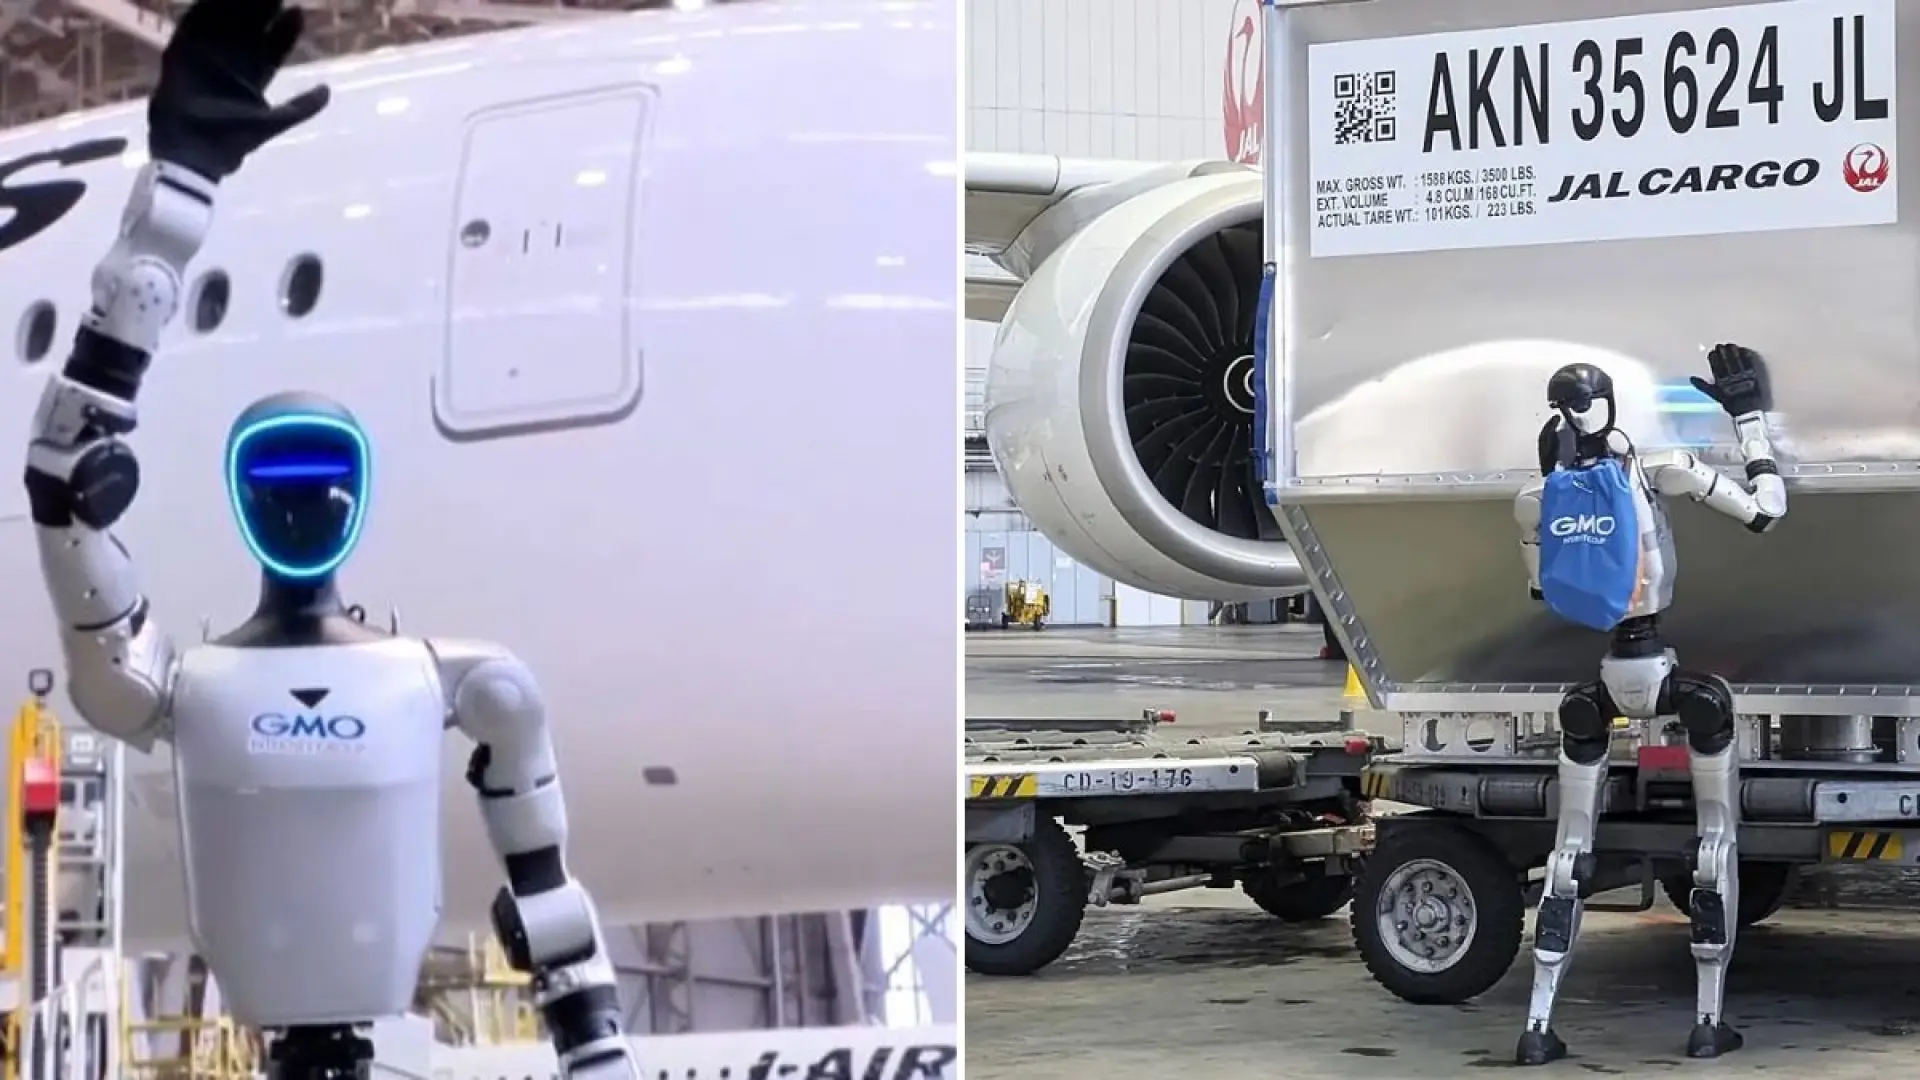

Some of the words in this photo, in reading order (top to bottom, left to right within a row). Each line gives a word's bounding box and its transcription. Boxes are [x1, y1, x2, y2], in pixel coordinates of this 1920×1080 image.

[1422, 43, 1550, 153] AKN
[1571, 37, 1645, 142] 35
[1663, 25, 1784, 134] 624
[1812, 15, 1889, 123] JL
[1237, 122, 1260, 161] JAL
[1317, 179, 1343, 194] MAX.
[1345, 176, 1384, 192] GROSS
[1386, 174, 1406, 189] WT.
[1421, 172, 1445, 187] 1588
[1447, 170, 1474, 185] KGS.
[1481, 167, 1508, 182] 3500
[1511, 165, 1537, 180] LBS.
[1548, 171, 1630, 203] JAL
[1638, 158, 1820, 196] CARGO
[1852, 177, 1878, 188] JAL
[1317, 196, 1340, 211] EXT.
[1342, 192, 1388, 209] VOLUME
[1426, 189, 1442, 204] 4.8
[1318, 213, 1361, 228] ACTUAL
[1364, 210, 1393, 225] TARE
[1487, 202, 1507, 217] 223
[1510, 200, 1537, 215] LBS.
[1550, 514, 1615, 536] GMO
[252, 712, 366, 740] GMO
[1899, 793, 1920, 817] C
